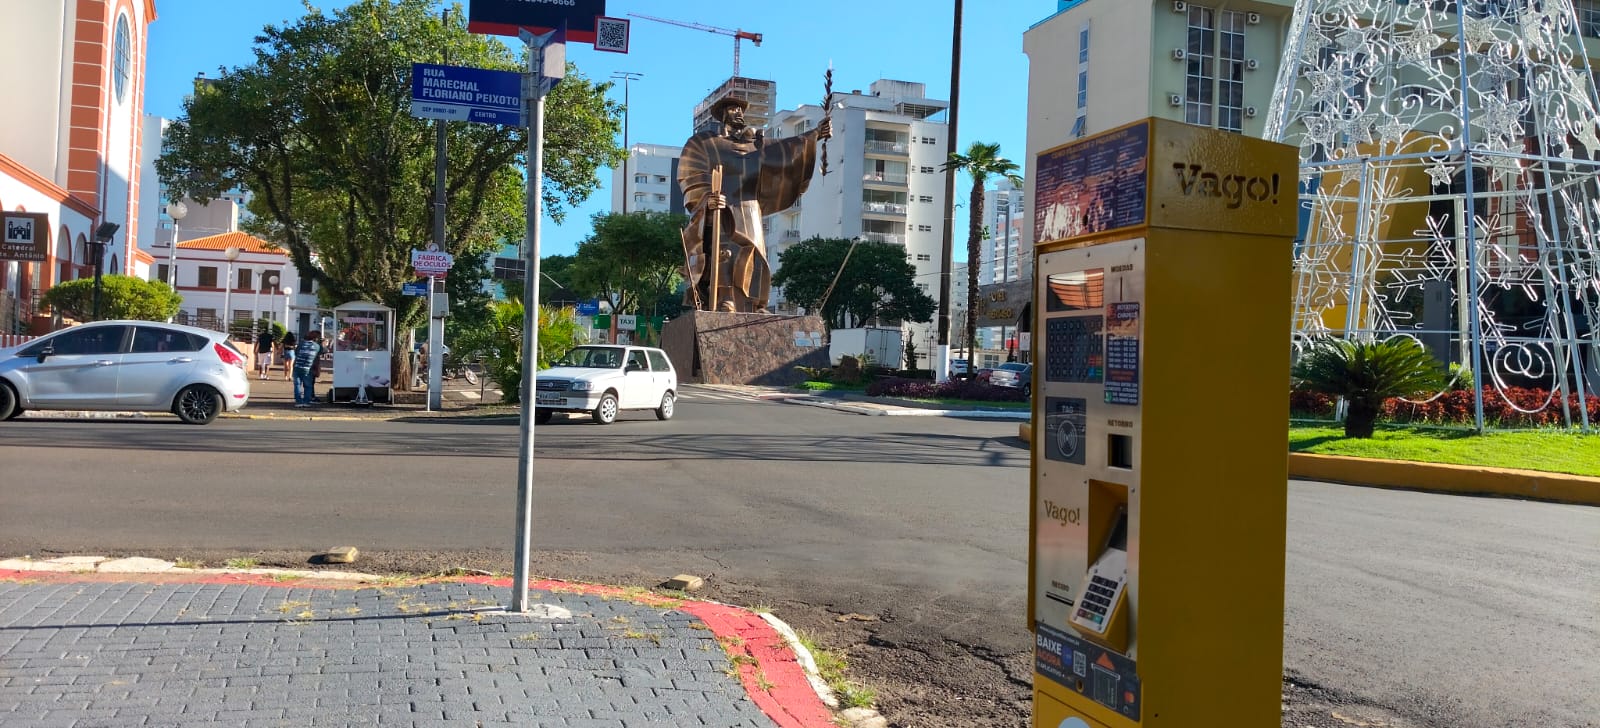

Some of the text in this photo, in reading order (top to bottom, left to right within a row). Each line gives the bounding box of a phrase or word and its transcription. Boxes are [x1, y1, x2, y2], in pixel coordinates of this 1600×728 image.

[423, 68, 446, 78] RUA
[423, 78, 480, 92] MARECHAL
[422, 87, 519, 106] FLORIANO PEIXOTO
[474, 111, 497, 119] CENTRO
[1173, 162, 1279, 209] Vago!
[1, 244, 36, 252] Catedral
[1043, 499, 1081, 527] Vago!
[1036, 634, 1062, 656] BAIXE
